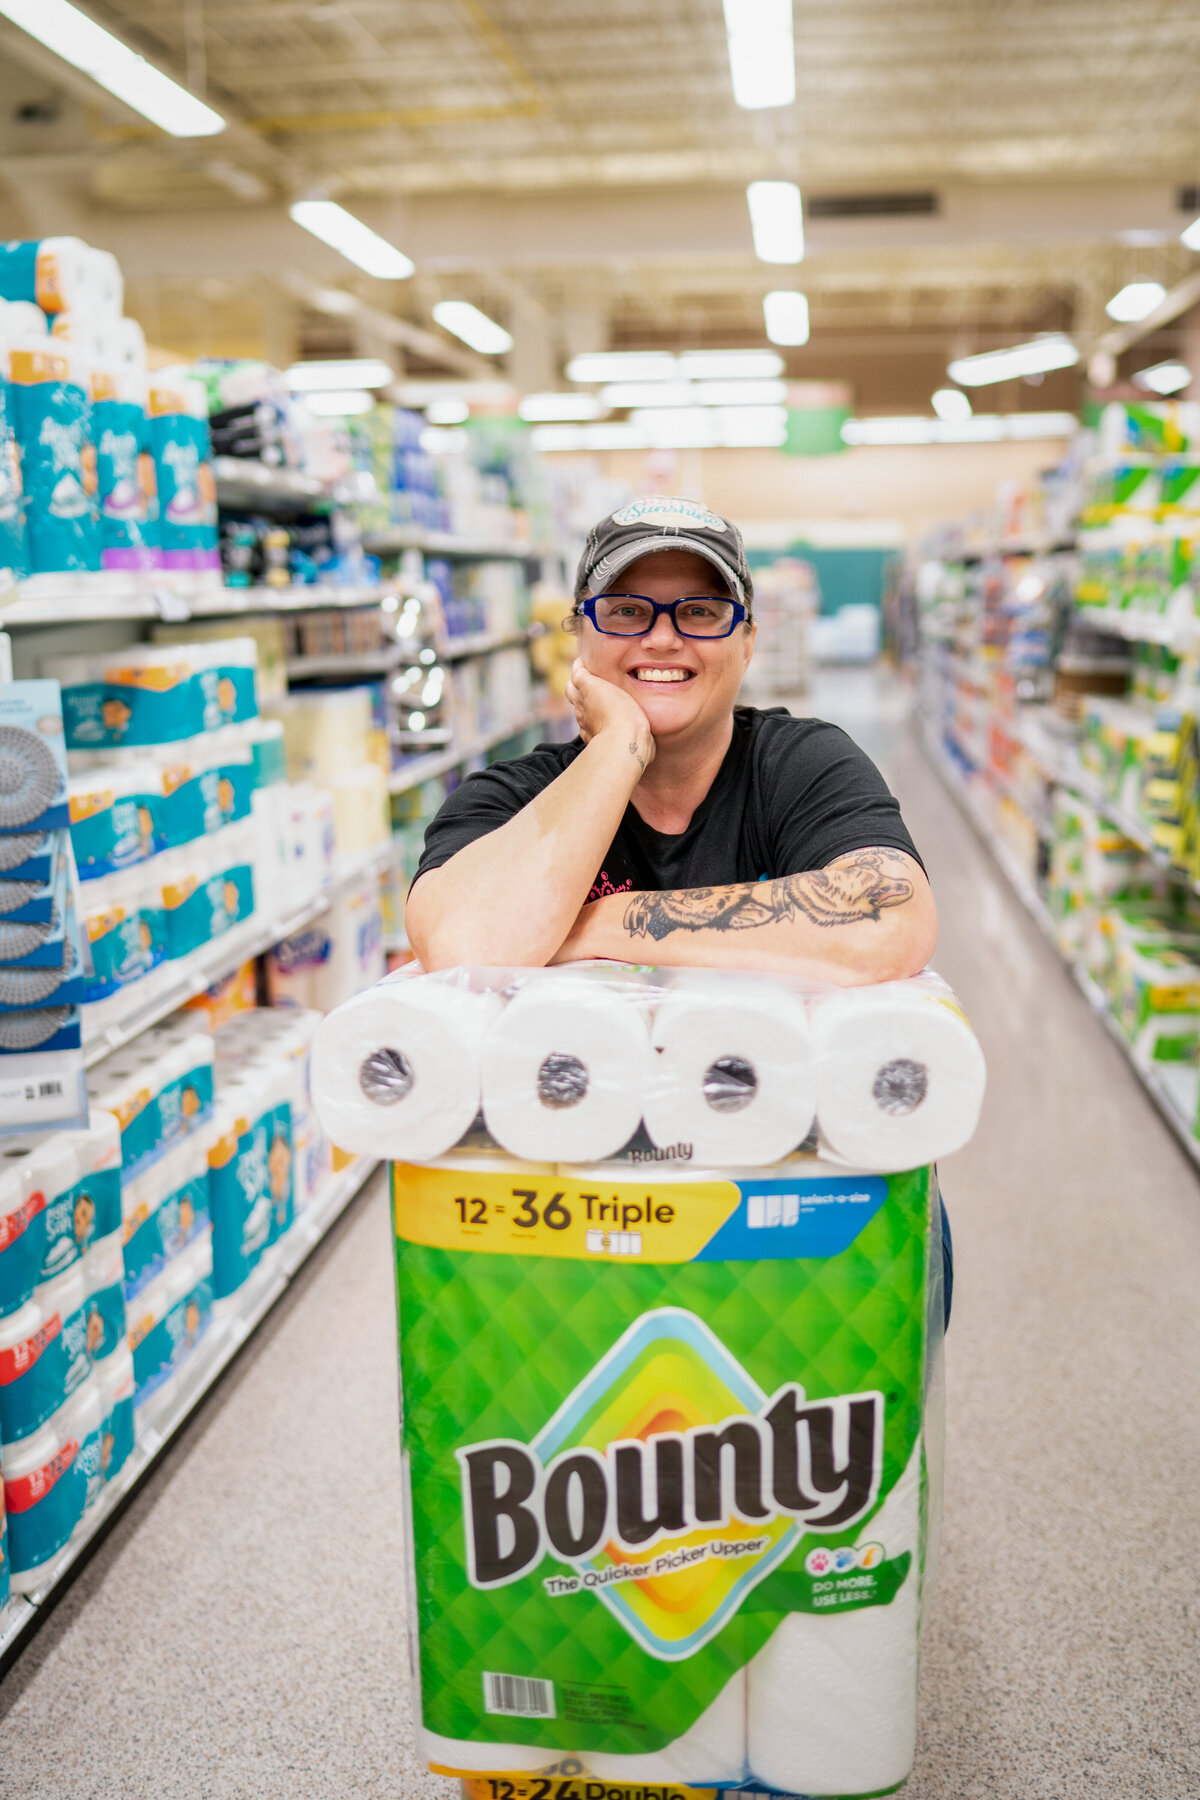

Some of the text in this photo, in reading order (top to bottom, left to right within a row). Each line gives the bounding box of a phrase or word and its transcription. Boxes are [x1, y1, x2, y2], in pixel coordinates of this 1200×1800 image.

[619, 502, 721, 527] Sunshine
[631, 1142, 693, 1163] Bounty
[454, 1197, 489, 1225] 12
[512, 1188, 572, 1231] 36
[578, 1193, 676, 1231] Triple
[461, 1386, 880, 1586] Bounty
[546, 1538, 764, 1594] The Quicker Picker Upper
[812, 1575, 878, 1594] DO MORE.
[813, 1590, 874, 1607] USE LESS.
[488, 1779, 515, 1800] 12
[529, 1778, 583, 1800] 24
[585, 1782, 687, 1800] Double
